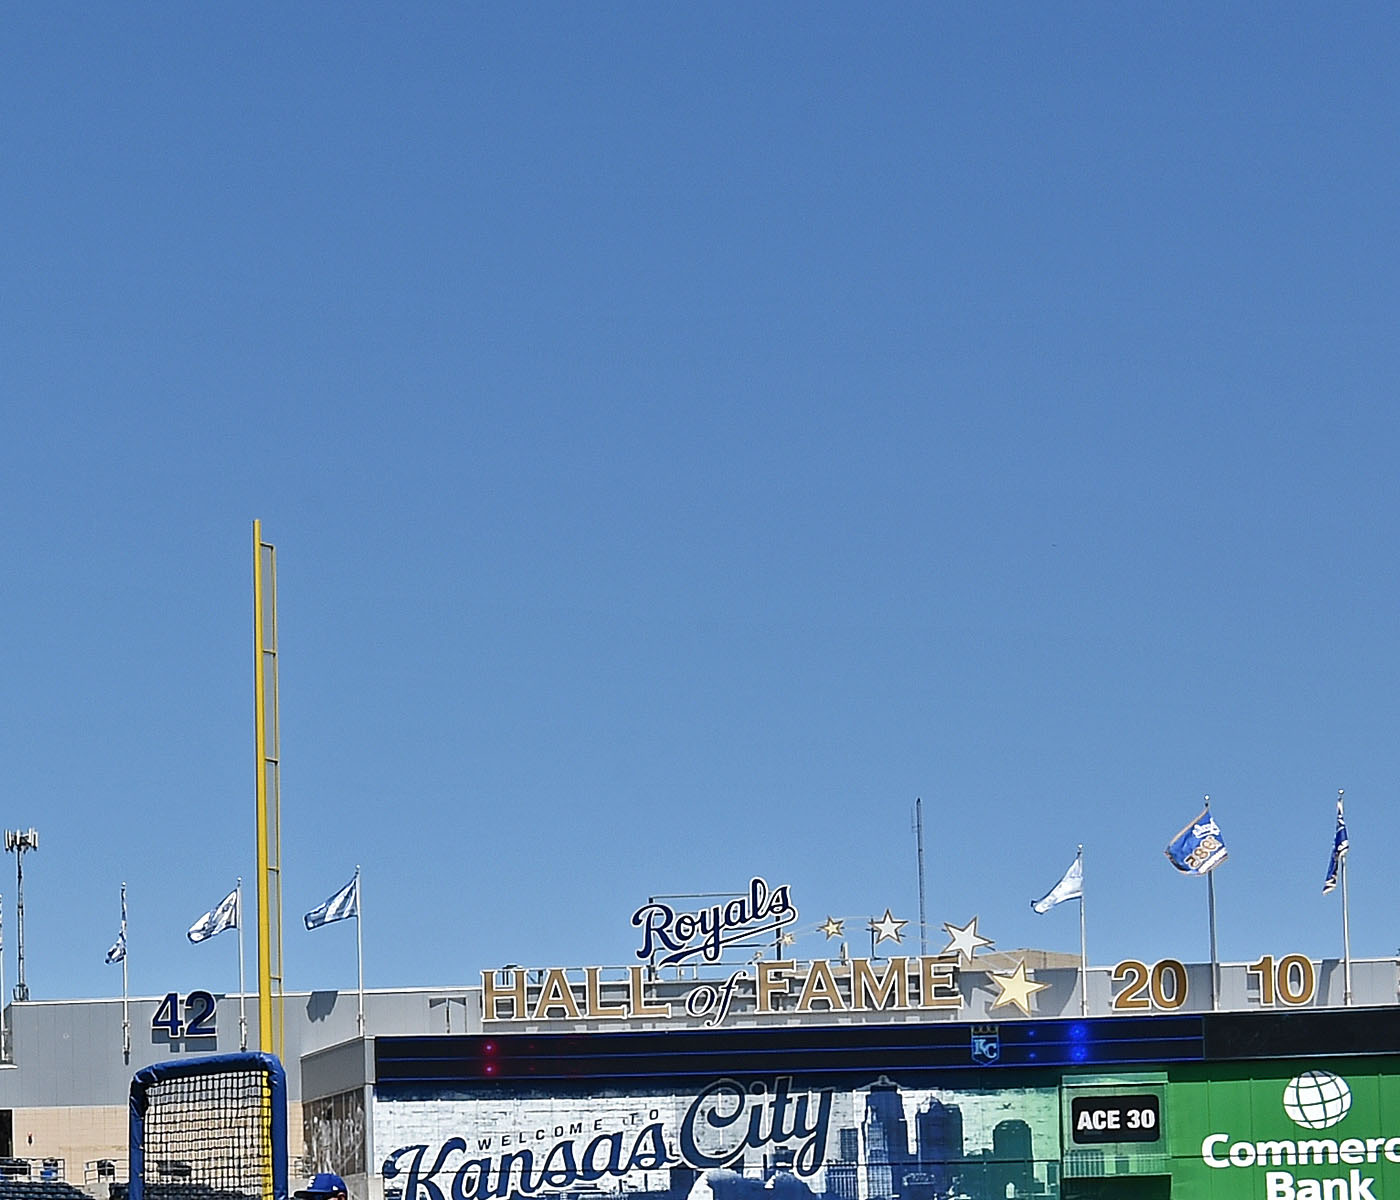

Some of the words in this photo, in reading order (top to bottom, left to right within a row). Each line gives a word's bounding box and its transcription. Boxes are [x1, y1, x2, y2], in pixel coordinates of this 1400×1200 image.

[632, 877, 798, 967] Royals
[481, 966, 672, 1022] HALL
[686, 970, 746, 1027] of
[754, 958, 963, 1014] FAME
[1112, 959, 1188, 1011] 20
[1248, 954, 1315, 1007] 10
[151, 989, 216, 1037] 42
[974, 1039, 997, 1058] KC
[478, 1118, 604, 1151] WELCOME
[629, 1108, 659, 1125] TO
[680, 1076, 834, 1176] City
[1077, 1110, 1120, 1131] ACE
[1126, 1109, 1155, 1129] 30
